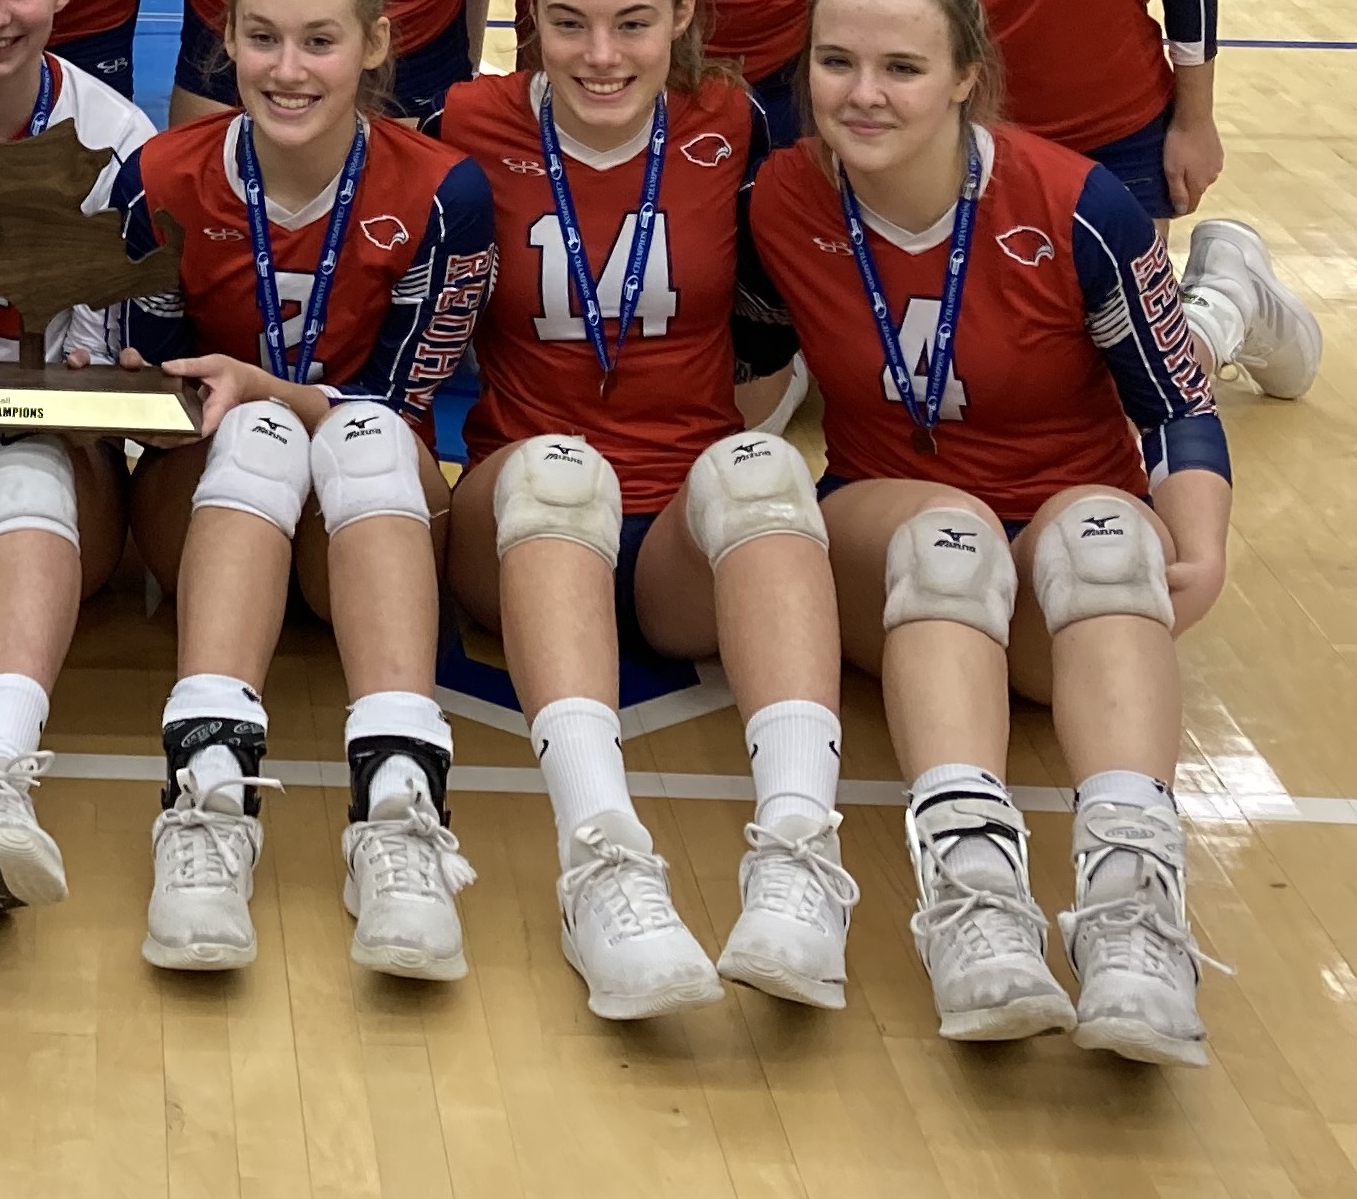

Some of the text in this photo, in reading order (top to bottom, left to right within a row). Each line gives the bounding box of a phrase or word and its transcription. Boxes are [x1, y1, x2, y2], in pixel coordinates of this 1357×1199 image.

[647, 157, 660, 201] CHAMPION
[556, 181, 572, 227] CHAMPION
[956, 202, 970, 248] CHAMPION
[254, 208, 266, 251] CHAMPION
[330, 206, 344, 249] CHAMPION
[633, 230, 647, 276] CHAMPION
[857, 245, 876, 292] CHAMPION
[312, 277, 327, 319] CHAMPION
[529, 213, 676, 341] 14
[574, 255, 590, 300] CHAMPION
[945, 276, 958, 323] CHAMPION
[264, 279, 276, 323] CHAMPION
[881, 320, 898, 366] CHAMPION
[882, 297, 967, 421] 4
[933, 353, 945, 396] CHAMPION
